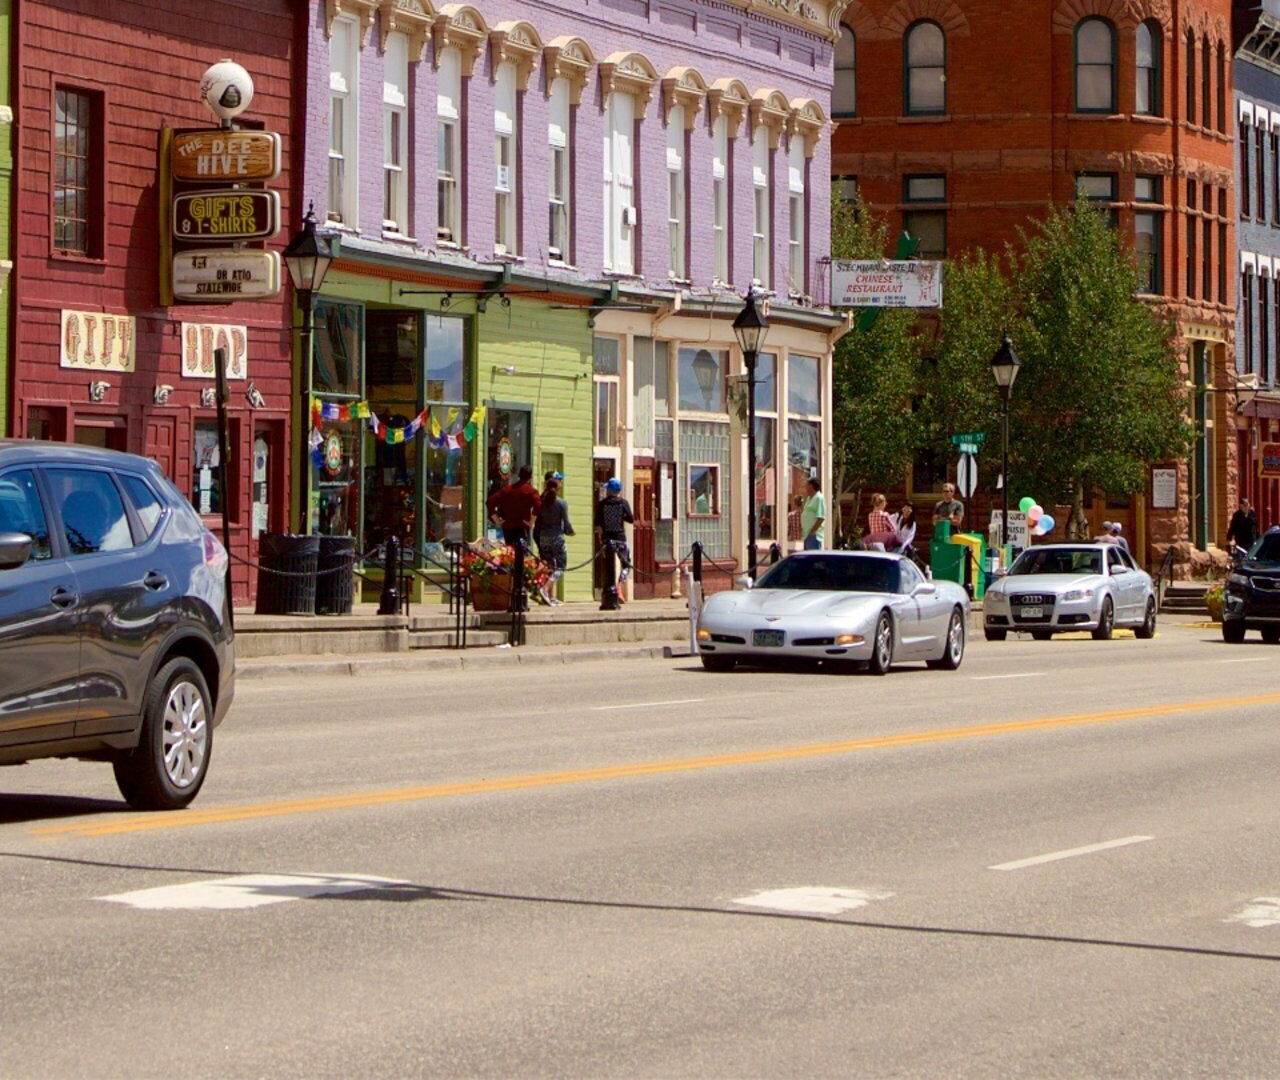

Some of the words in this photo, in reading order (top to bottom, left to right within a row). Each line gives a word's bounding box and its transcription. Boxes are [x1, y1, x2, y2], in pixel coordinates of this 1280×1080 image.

[178, 137, 203, 157] THE
[196, 155, 248, 175] HIVE
[189, 196, 254, 219] GIFTS
[196, 217, 257, 234] T-SHIRTS
[196, 282, 243, 294] STATEWIDE
[846, 284, 904, 293] RESTAURANT
[855, 274, 894, 284] CHINESE
[65, 313, 132, 368] GIFT
[185, 325, 246, 375] SHOP
